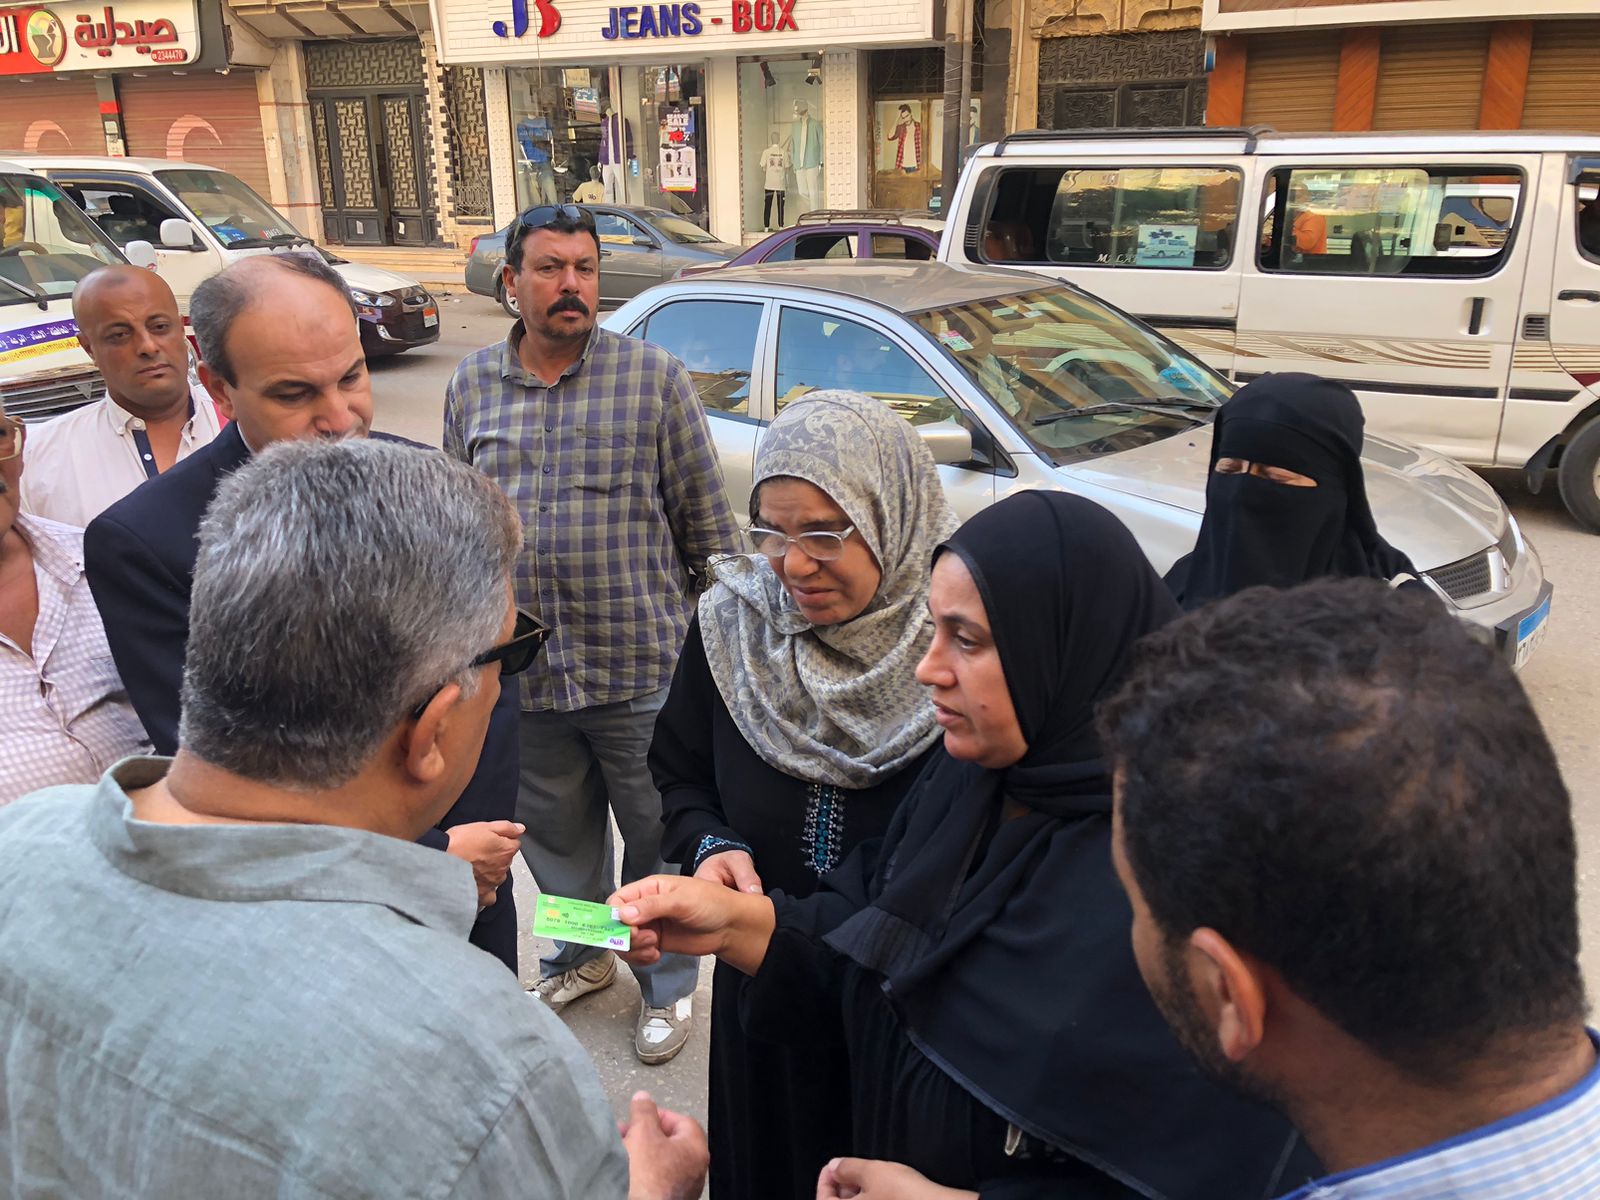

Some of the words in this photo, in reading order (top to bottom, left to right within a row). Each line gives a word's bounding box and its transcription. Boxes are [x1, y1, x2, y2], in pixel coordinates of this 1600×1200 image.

[74, 6, 178, 57] صيدلية
[601, 2, 702, 40] JEANS
[731, 0, 799, 33] BOX
[666, 118, 689, 126] SALE
